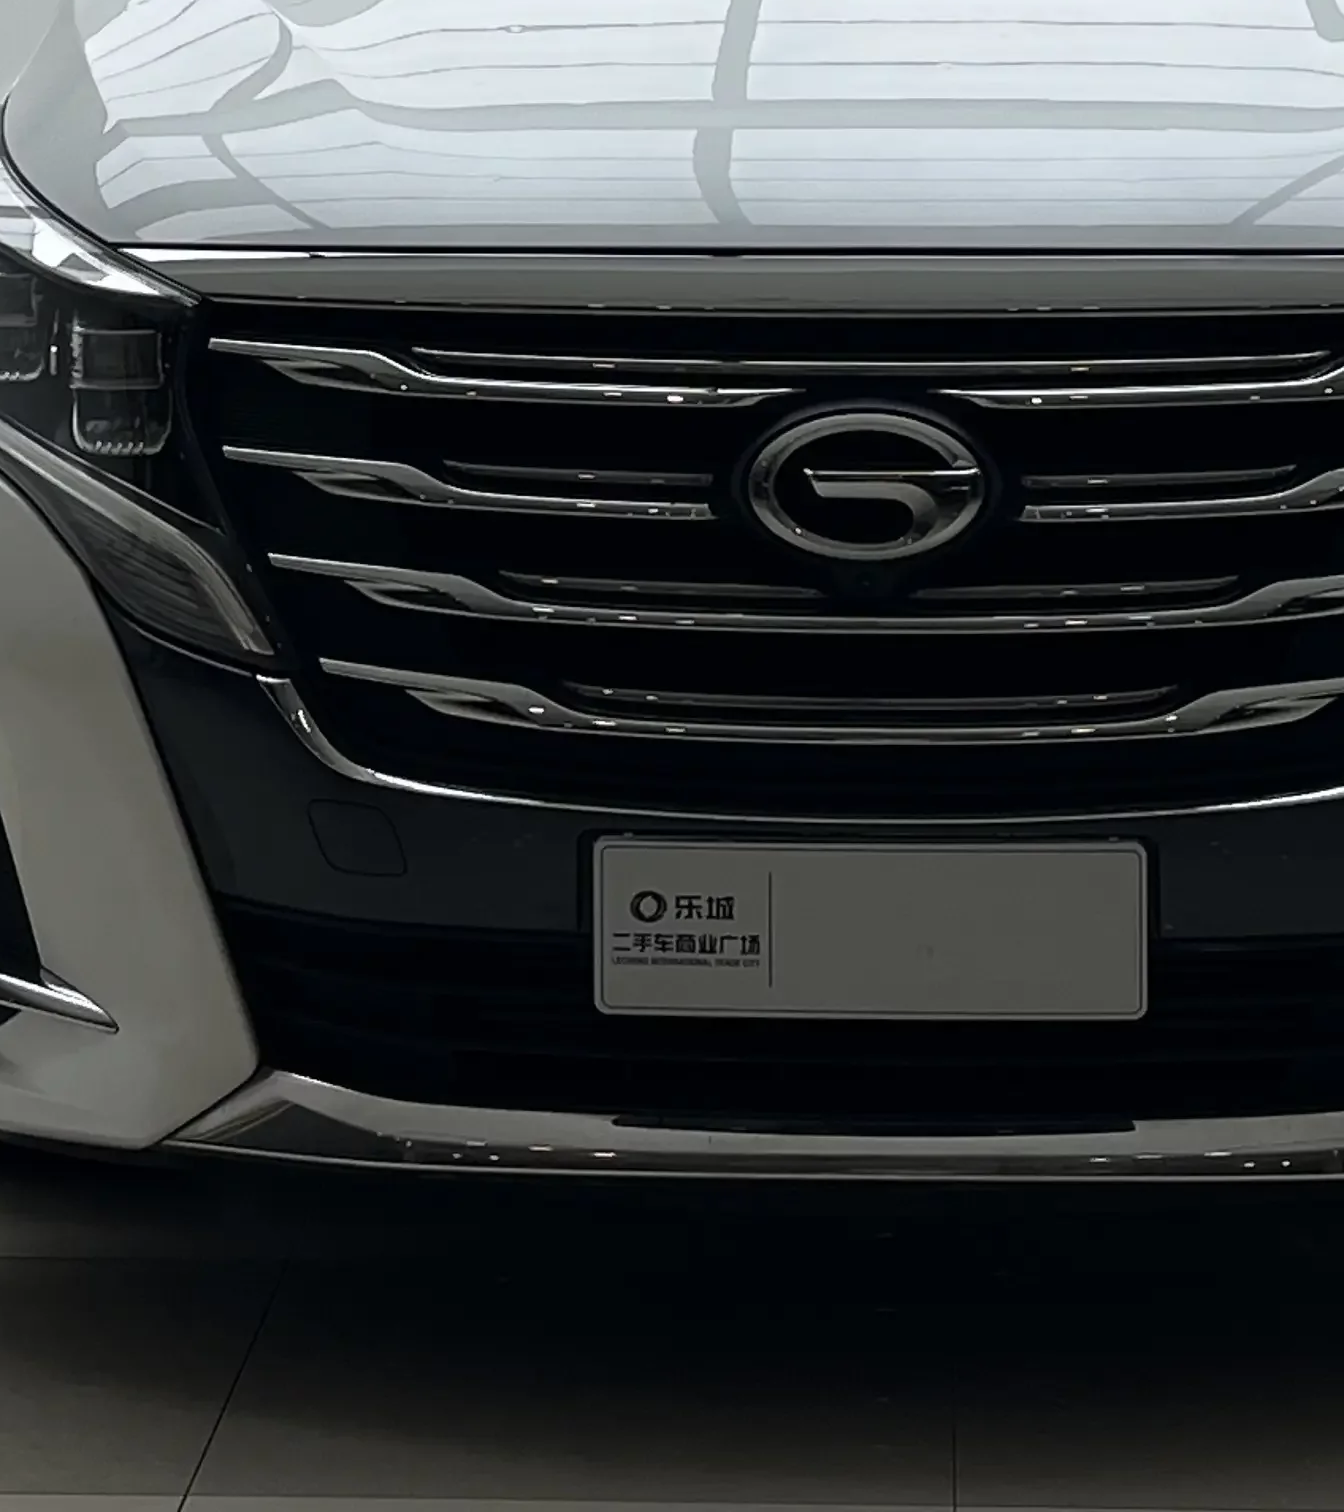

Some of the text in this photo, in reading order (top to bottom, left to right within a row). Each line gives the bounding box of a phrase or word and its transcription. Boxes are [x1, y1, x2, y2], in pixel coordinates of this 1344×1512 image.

[674, 894, 735, 921] 乐城
[612, 932, 761, 956] 二手车商业广场
